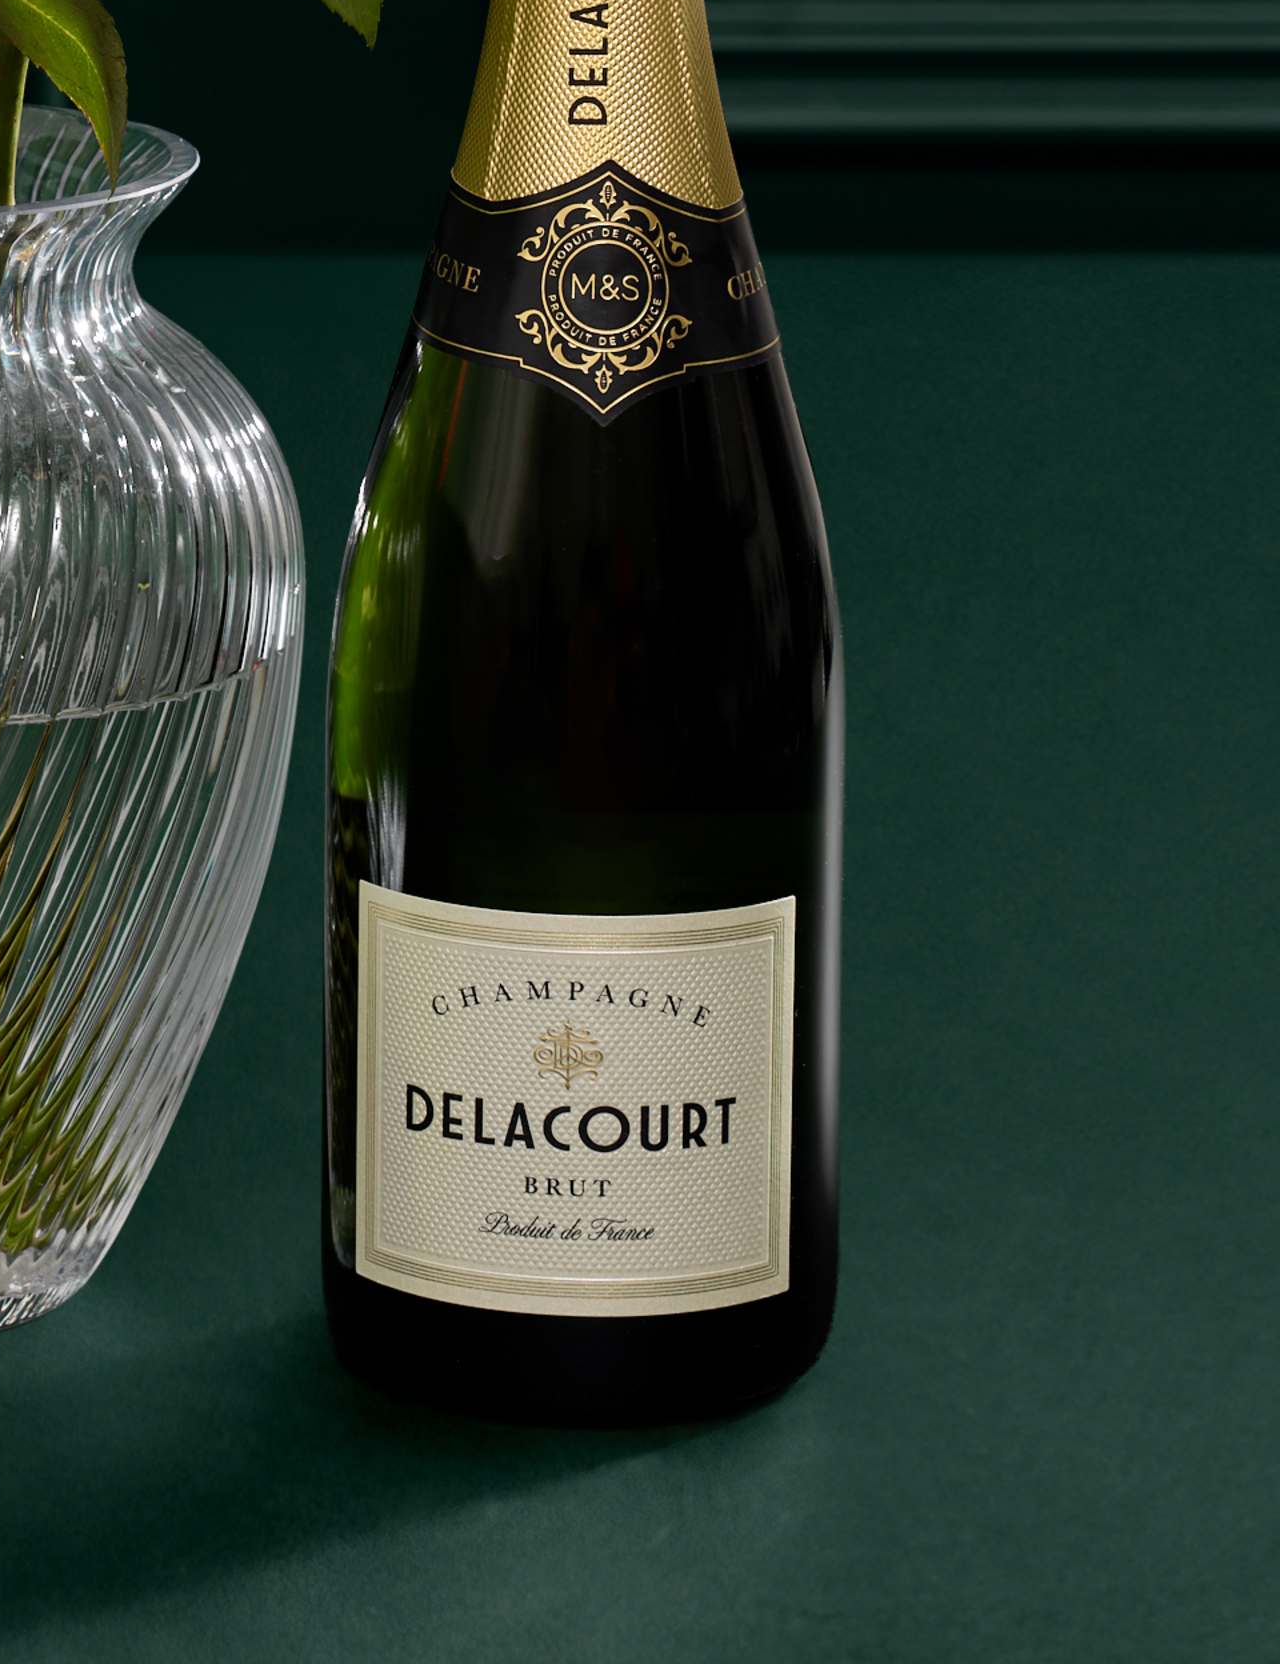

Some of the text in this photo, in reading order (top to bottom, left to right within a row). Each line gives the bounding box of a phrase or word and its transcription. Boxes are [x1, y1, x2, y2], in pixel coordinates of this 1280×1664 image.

[549, 228, 663, 281] PRODUIT DE FRANCE
[571, 273, 639, 302] M&S
[548, 294, 663, 347] PRODUIT DE FRANCE
[431, 980, 711, 1028] CHAMPAGNE
[405, 1084, 737, 1153] DELACOURT
[523, 1176, 612, 1198] BRUT
[478, 1211, 655, 1241] Produit de France
